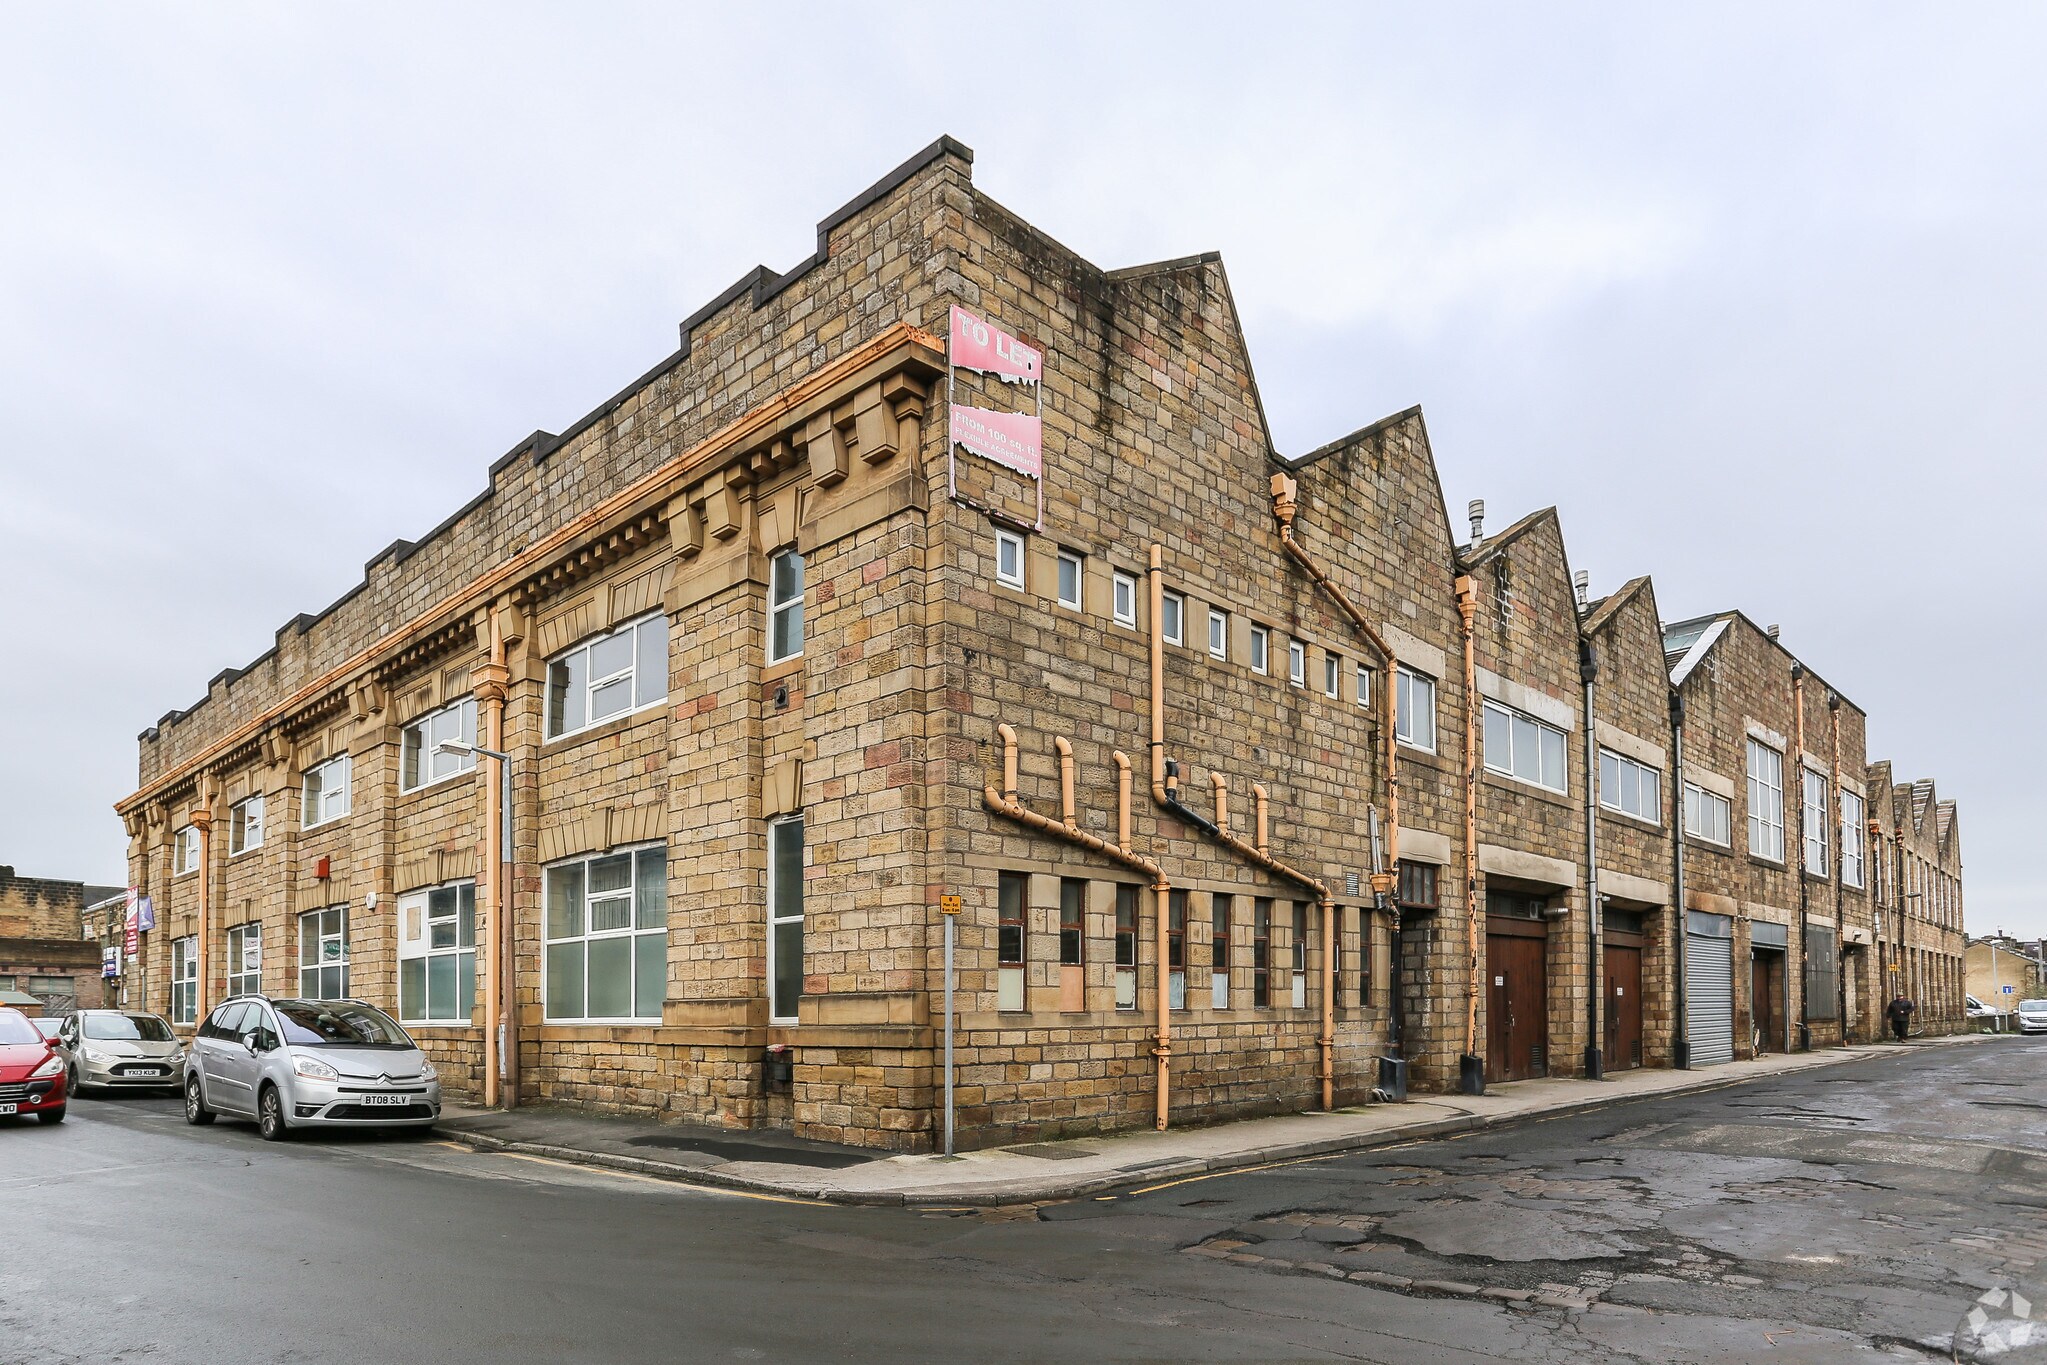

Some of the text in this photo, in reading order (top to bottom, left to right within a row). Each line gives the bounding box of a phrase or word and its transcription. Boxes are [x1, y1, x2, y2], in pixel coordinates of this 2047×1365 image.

[957, 312, 1037, 372] TO LET
[955, 412, 985, 433] FROM
[988, 428, 1007, 444] 100
[1009, 439, 1024, 452] sq.
[955, 427, 1038, 470] FLEXIBLE AGREEMENTS
[365, 1096, 388, 1104] BT08
